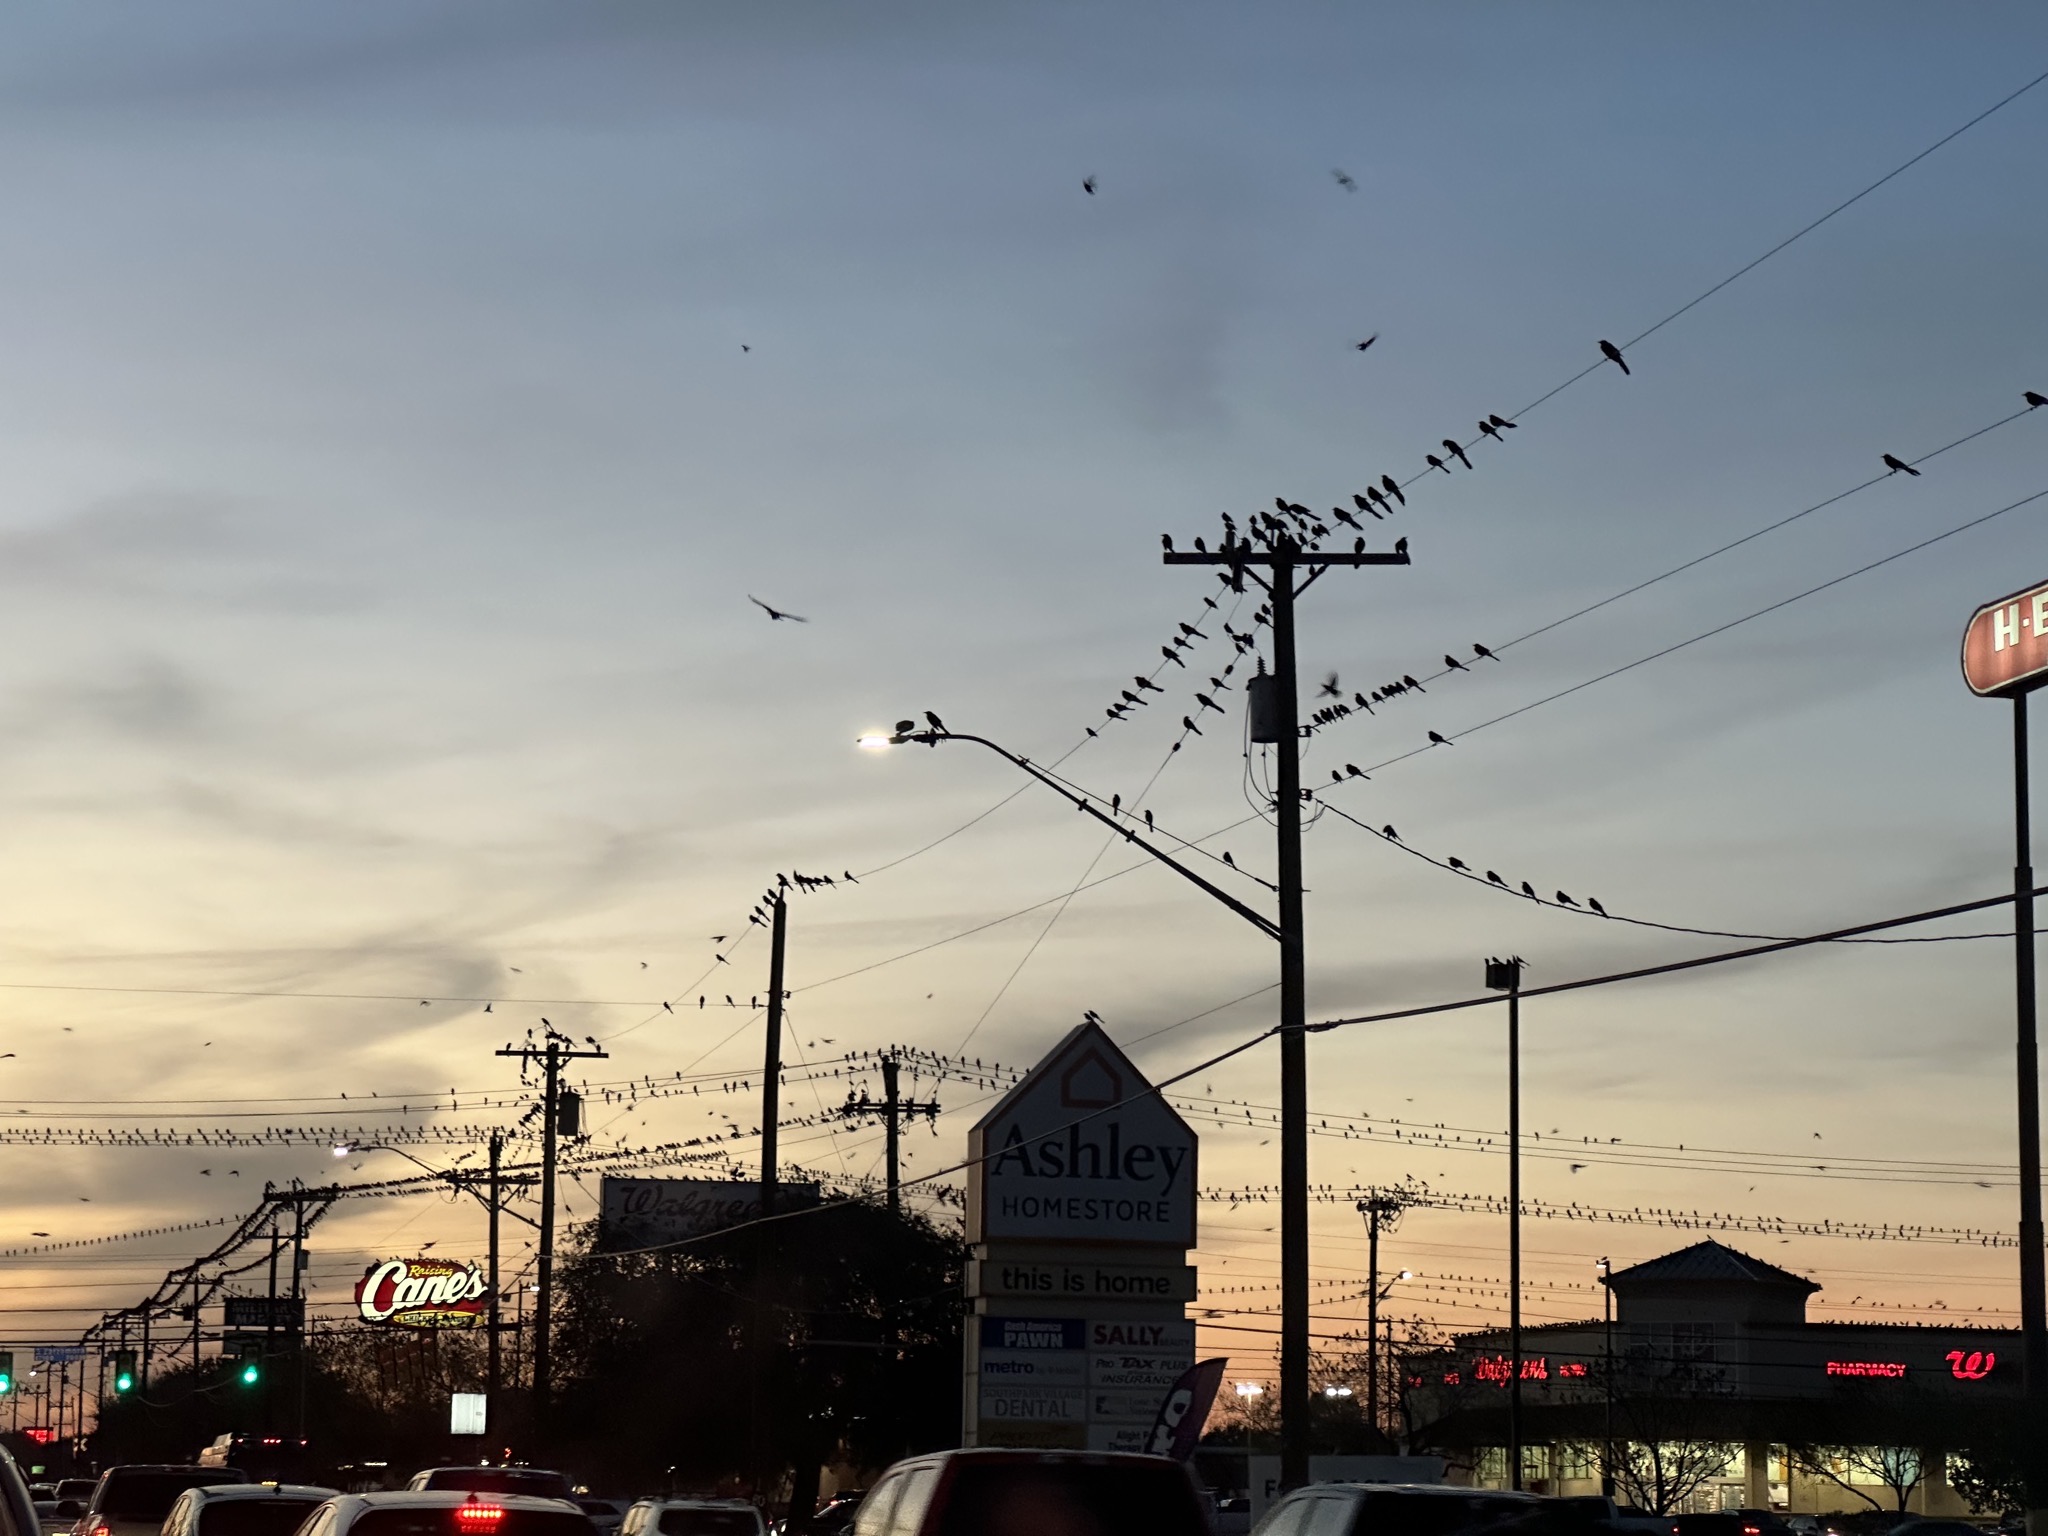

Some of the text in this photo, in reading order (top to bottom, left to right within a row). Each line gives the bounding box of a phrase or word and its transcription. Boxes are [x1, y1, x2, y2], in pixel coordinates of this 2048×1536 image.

[991, 1122, 1189, 1197] Ashley
[1003, 1196, 1170, 1223] HOMESTORE
[408, 1264, 453, 1279] Raising
[1002, 1267, 1170, 1294] this is home
[360, 1259, 489, 1321] Cane's
[1026, 1322, 1063, 1332] America
[1093, 1324, 1163, 1346] SALLY
[1004, 1332, 1064, 1348] PAWN
[984, 1360, 1034, 1374] metro
[1160, 1360, 1188, 1370] PLUS
[1826, 1361, 1907, 1378] PHARMACY
[983, 1388, 1084, 1400] SOUTHPARK VILLAGE
[995, 1398, 1071, 1418] DENTAL
